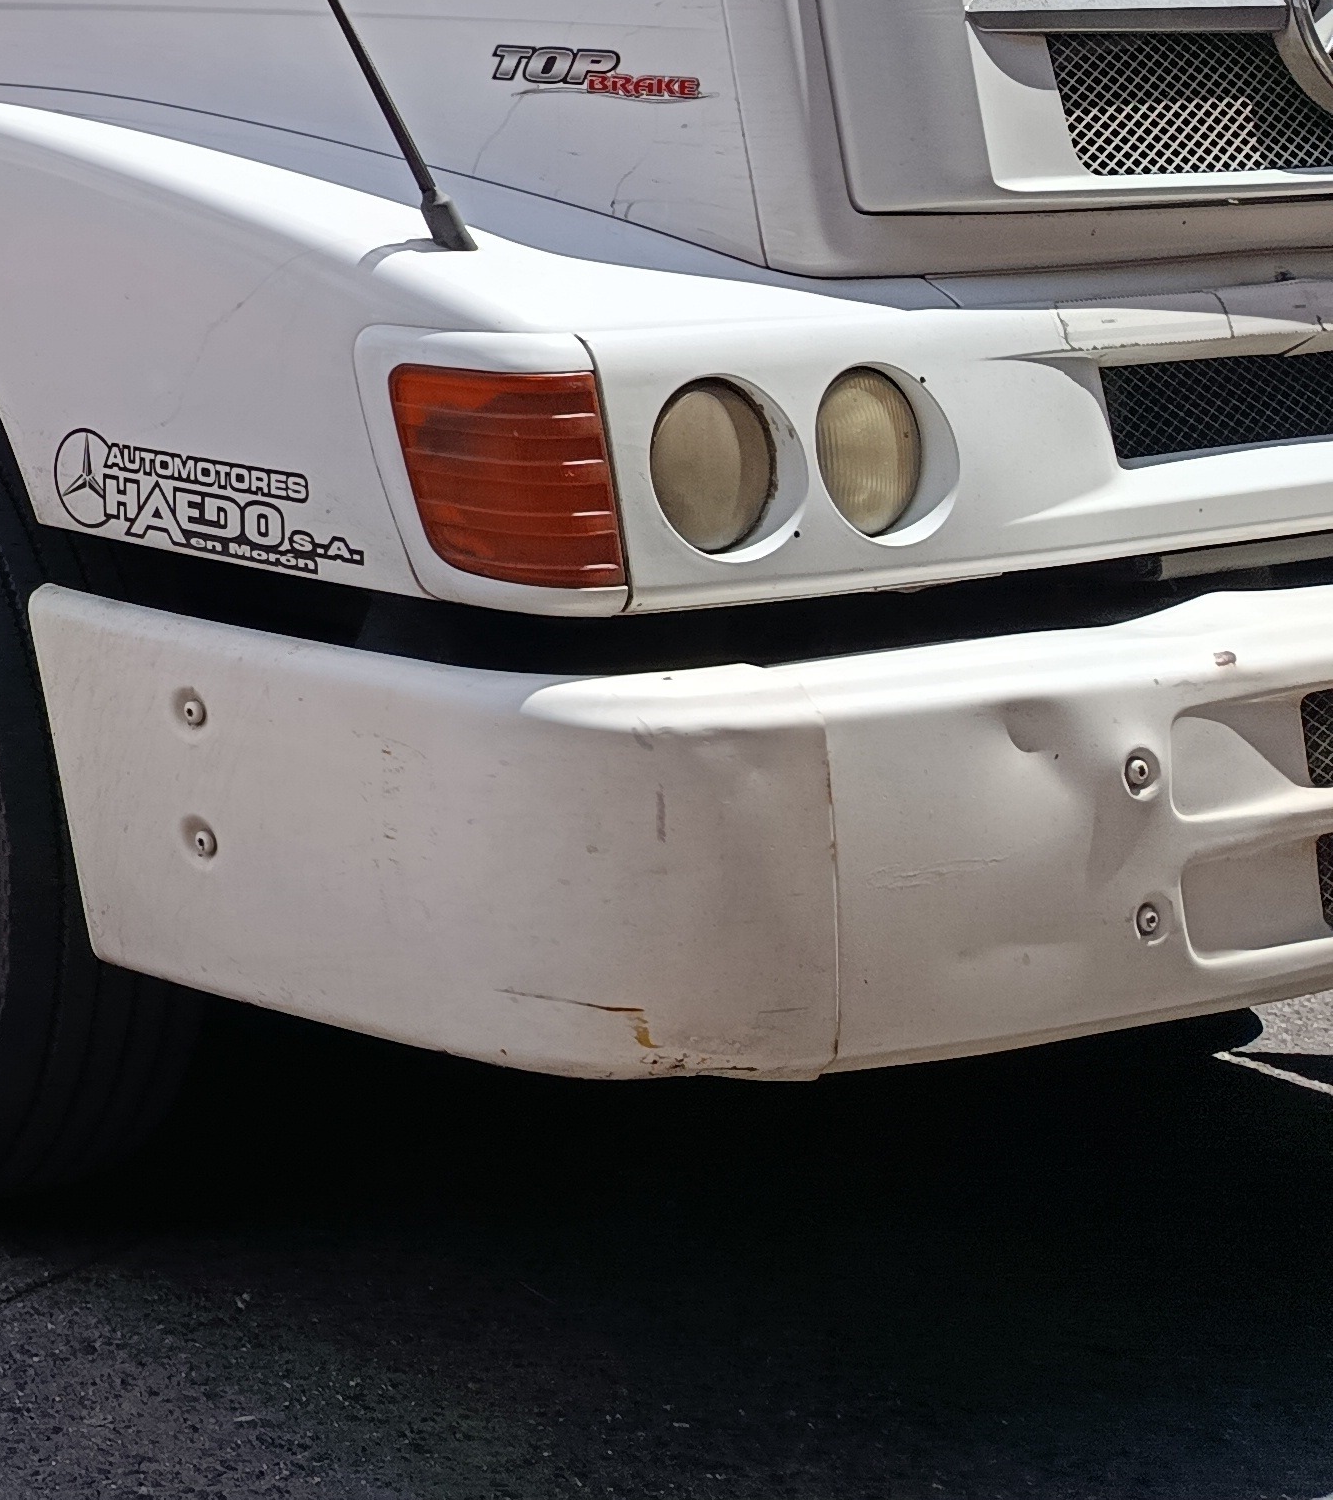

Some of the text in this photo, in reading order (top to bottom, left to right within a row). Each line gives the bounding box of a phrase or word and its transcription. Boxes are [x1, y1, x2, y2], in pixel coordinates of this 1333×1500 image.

[492, 44, 621, 86] TOP
[586, 73, 701, 98] BRAKE
[104, 444, 308, 503] AUTOMOTORES
[104, 474, 364, 565] HAEDO S.A.
[189, 536, 317, 571] en Morón
